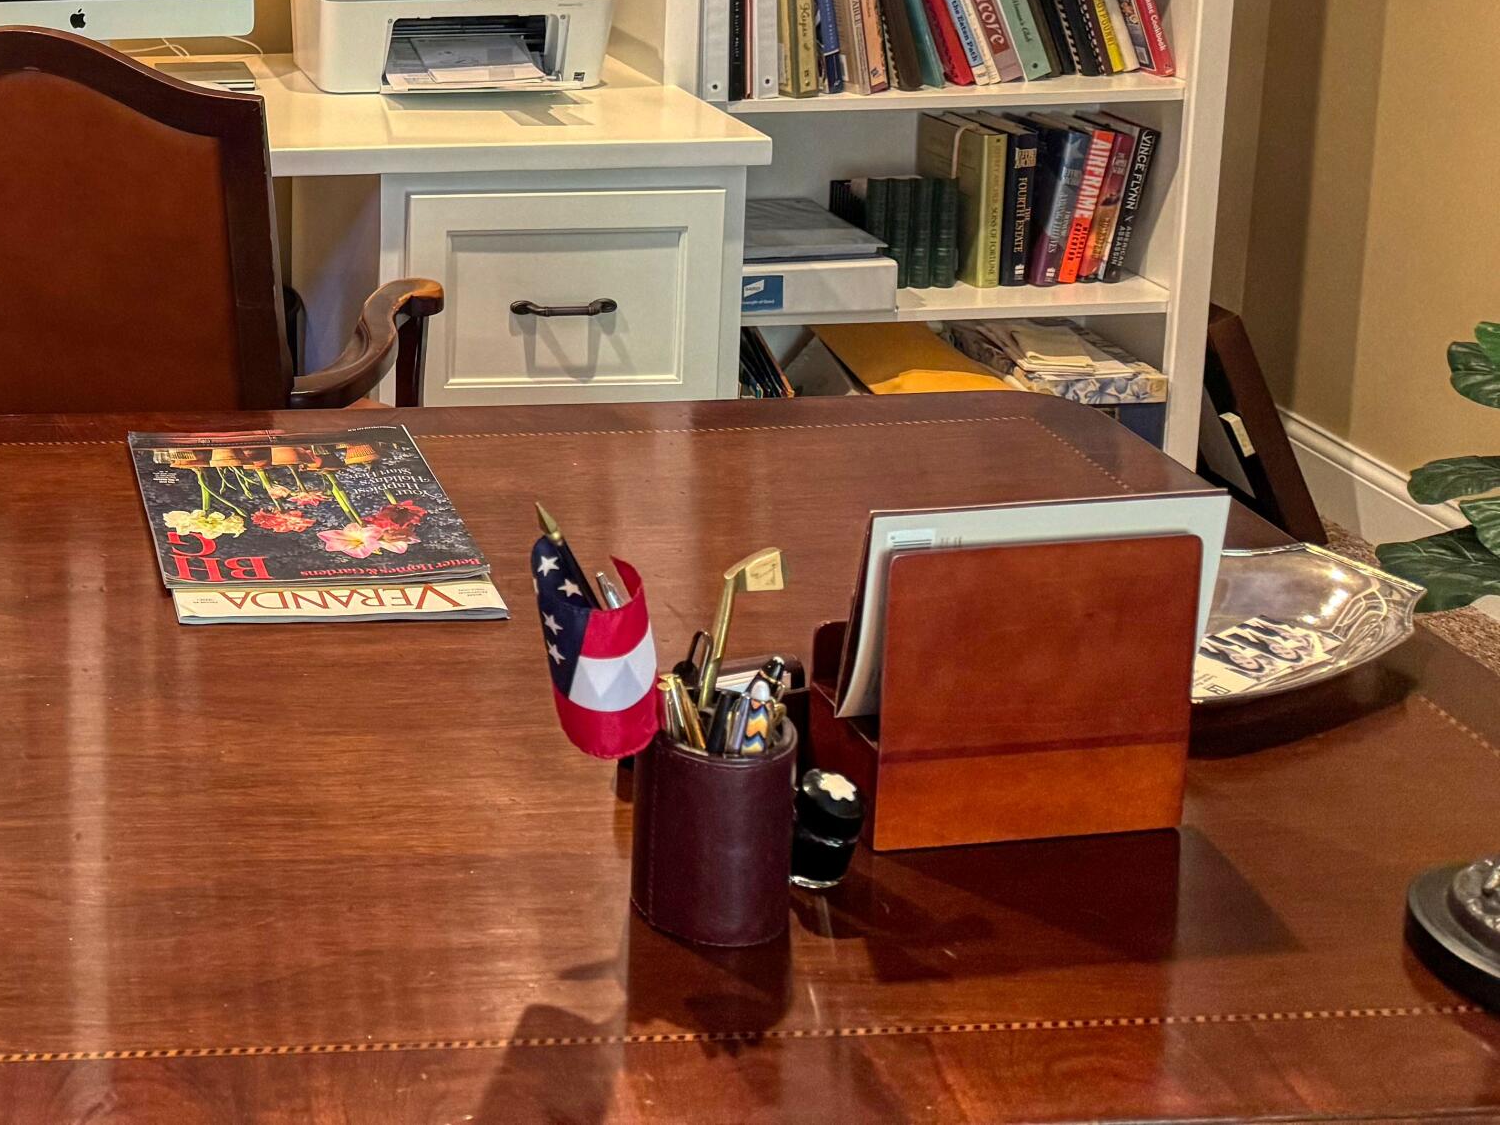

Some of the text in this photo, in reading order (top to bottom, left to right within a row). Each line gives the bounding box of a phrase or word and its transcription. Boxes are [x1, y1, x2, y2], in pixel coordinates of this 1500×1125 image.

[950, 0, 963, 15] the
[956, 15, 971, 38] Eaten
[1148, 14, 1167, 52] Cookbook
[963, 37, 979, 63] Path
[1075, 138, 1112, 218] AIRFRAME
[1125, 135, 1153, 209] VINCE FLYNN
[1014, 177, 1028, 252] FOURTH ESTATE
[1111, 225, 1126, 265] ASSASSIN
[1117, 226, 1132, 266] AMERICAN
[352, 482, 419, 494] Happiest
[359, 475, 430, 486] Holidays
[166, 531, 217, 557] G
[170, 555, 273, 583] BH
[300, 558, 482, 577] Better Homes Gardens
[217, 584, 466, 610] VERANDA
